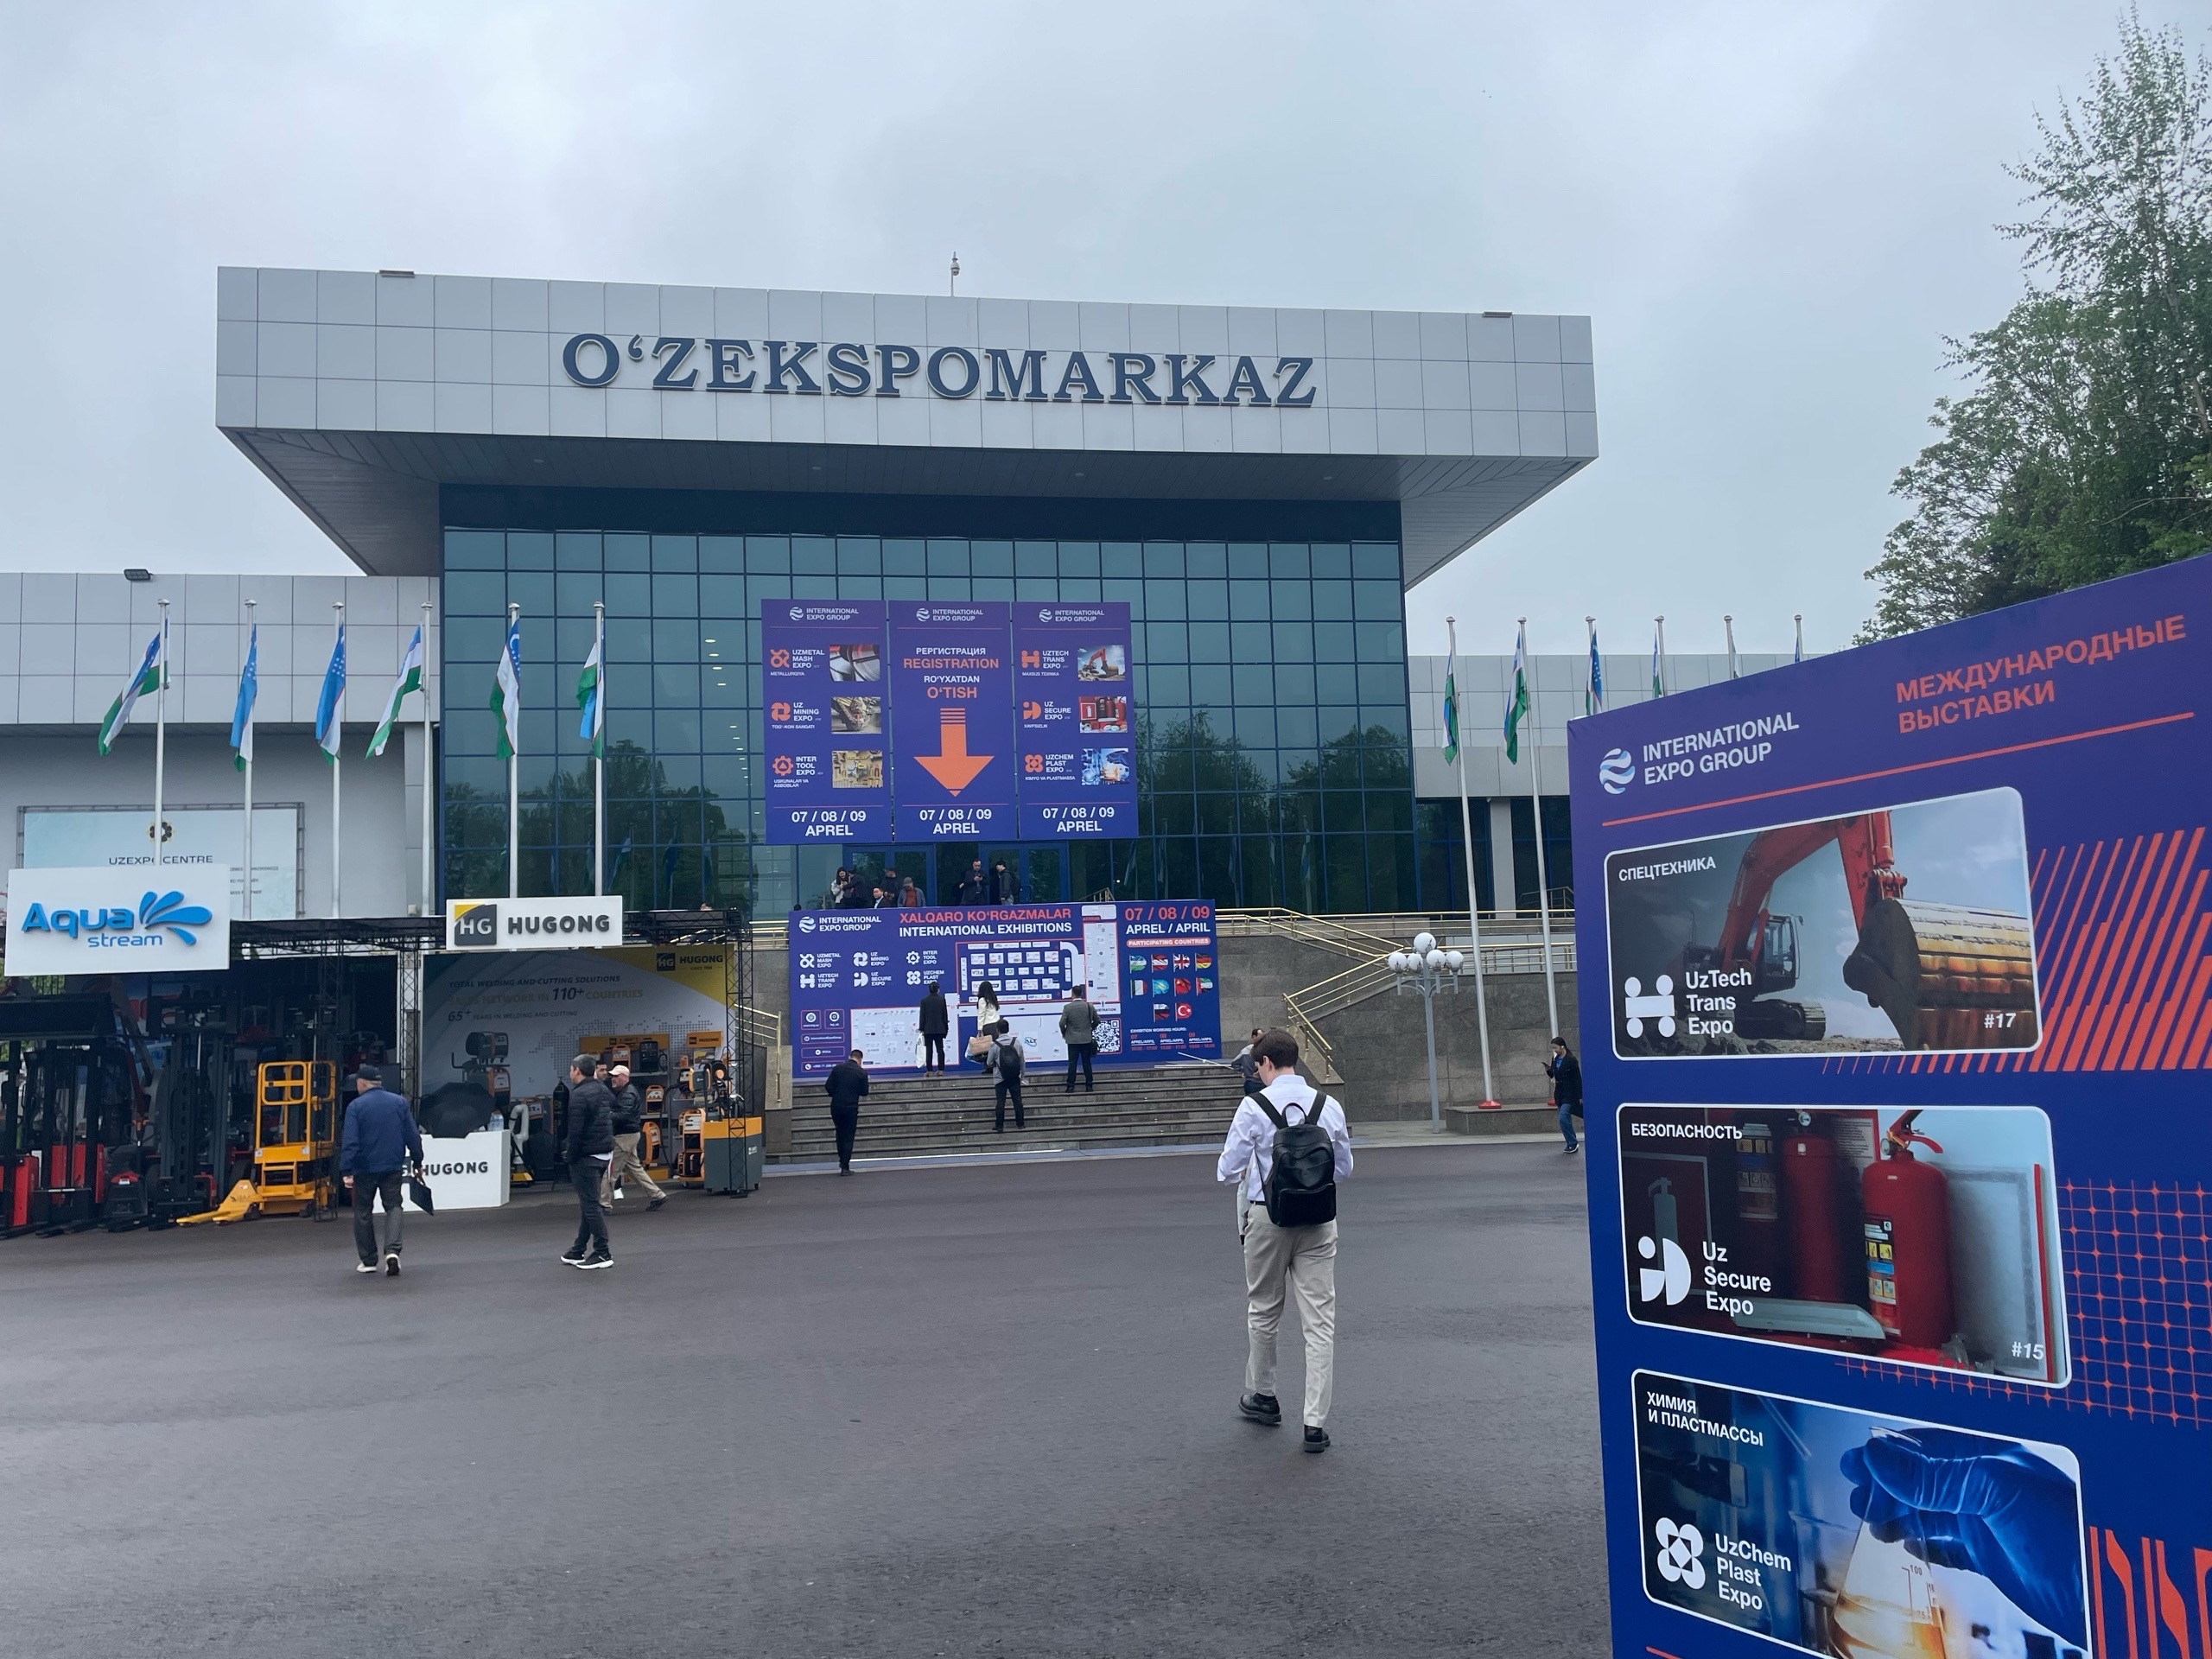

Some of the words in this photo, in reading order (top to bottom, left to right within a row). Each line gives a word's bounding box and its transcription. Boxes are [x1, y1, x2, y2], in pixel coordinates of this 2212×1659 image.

[563, 334, 1317, 408] O‘ZEKSPOMARKAZ
[903, 658, 999, 669] REGISTRATION
[1897, 614, 2186, 703] МЕЖДУНАРОДНЫЕ
[927, 687, 977, 698] O‘TISH
[1898, 680, 2055, 734] ВЫСТАВКИ
[1643, 712, 1799, 762] INTERNATIONAL
[1644, 760, 1694, 785] EXPO
[1700, 741, 1772, 773] GROUP
[791, 811, 808, 823] 07
[821, 811, 837, 822] 08
[850, 810, 867, 822] 09
[919, 810, 935, 820] 07
[948, 809, 963, 820] 08
[976, 809, 992, 820] 09
[1043, 808, 1058, 818] 07
[1071, 807, 1086, 818] 08
[1099, 807, 1115, 818] 09
[805, 824, 854, 836] APREL
[933, 823, 980, 834] APREL
[1056, 821, 1103, 832] APREL
[109, 855, 213, 865] UZEXPCENTRE
[1618, 855, 1716, 881] СПЕЦТЕХНИКА
[21, 902, 135, 939] Aqua
[899, 912, 963, 924] XALQARO
[968, 908, 1071, 921] KO‘RGAZMALAR
[1124, 908, 1142, 921] 07
[1158, 907, 1177, 920] 08
[1192, 906, 1210, 919] 09
[460, 918, 493, 935] HG
[508, 914, 610, 934] HUGONG
[899, 925, 995, 938] INTERNATIONAL
[997, 922, 1072, 934] EXHIBITIONS
[1126, 924, 1166, 934] APREL
[1175, 923, 1211, 932] APRIL
[87, 932, 162, 948] stream
[658, 958, 674, 967] HG
[680, 955, 723, 963] HUGONG
[477, 979, 515, 988] WELDING
[537, 976, 573, 985] CUTTING
[575, 975, 620, 983] SOLUTIONS
[1686, 968, 1752, 989] UzTech
[552, 987, 585, 1001] 110+
[586, 989, 644, 1000] COUNTRIES
[1687, 995, 1736, 1012] Trans
[1688, 1017, 1733, 1038] Expo
[1984, 1013, 2016, 1028] #17
[1631, 1123, 1743, 1140] БЕЗОПАСНОСТЬ
[1702, 1241, 1728, 1262] Uz
[1704, 1266, 1771, 1293] Secure
[1706, 1290, 1754, 1317] Expo
[2012, 1341, 2044, 1360] #15
[1647, 1391, 1696, 1414] ХИМИЯ
[1648, 1408, 1658, 1423] И
[1662, 1412, 1764, 1446] ПЛАСТМАССЫ
[1715, 1533, 1791, 1572] UzChem
[1717, 1556, 1761, 1587] Plast
[1910, 1565, 1923, 1576] 100
[1718, 1580, 1763, 1611] Expo
